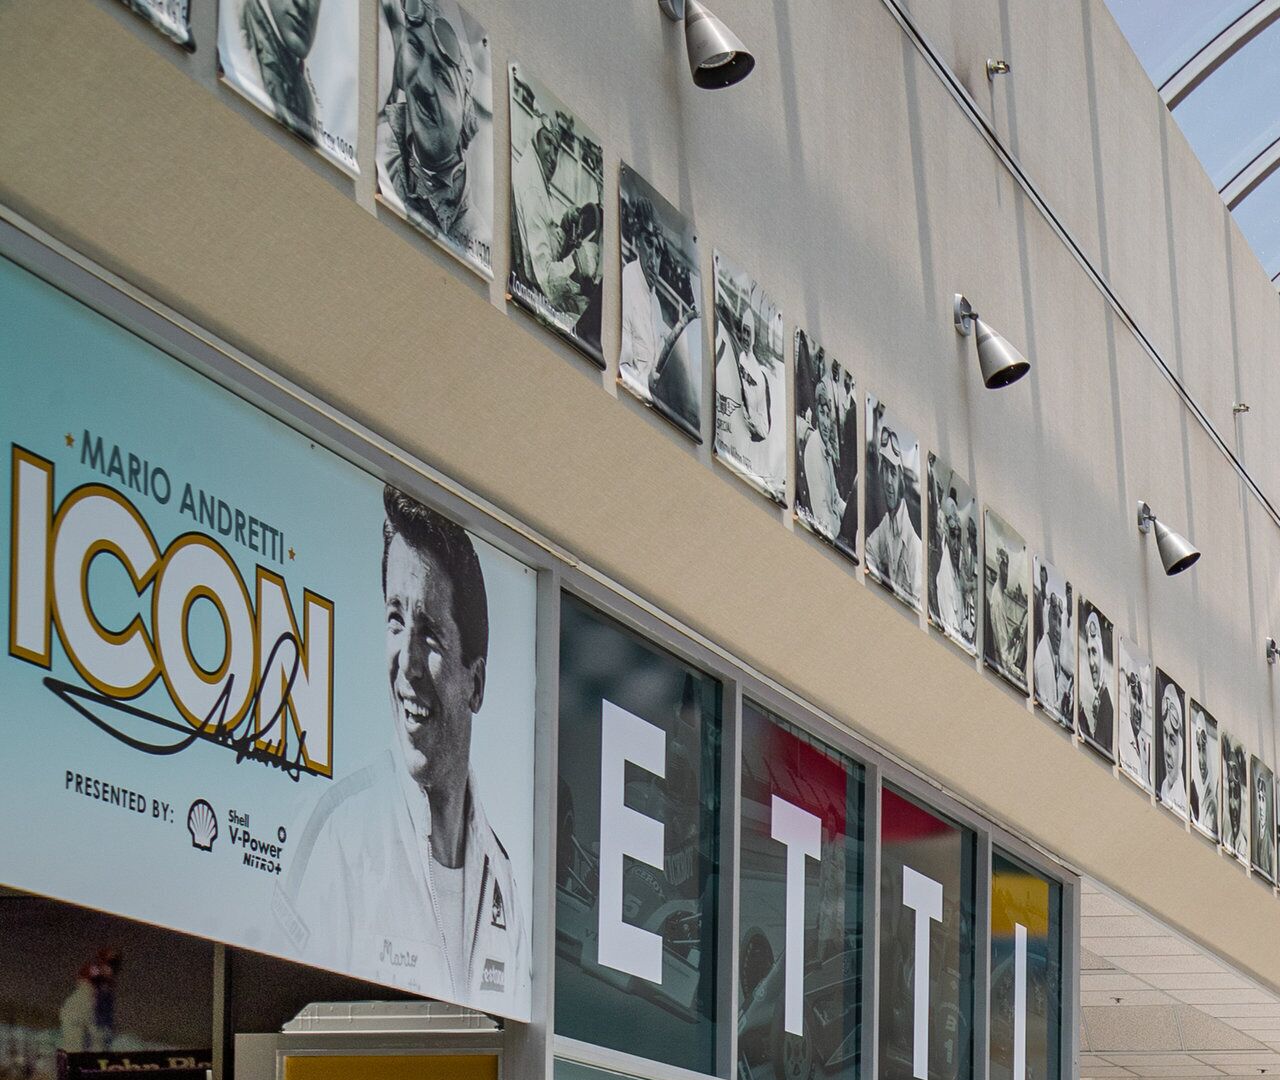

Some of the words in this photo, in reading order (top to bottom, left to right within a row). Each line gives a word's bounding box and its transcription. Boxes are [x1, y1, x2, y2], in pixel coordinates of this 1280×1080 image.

[80, 428, 171, 505] MARIO
[179, 482, 285, 565] ANDRETTI
[8, 441, 335, 780] ICON
[65, 770, 147, 814] PRESENTED
[152, 799, 174, 824] BY:
[228, 809, 250, 828] Shell
[229, 825, 282, 859] V-Power
